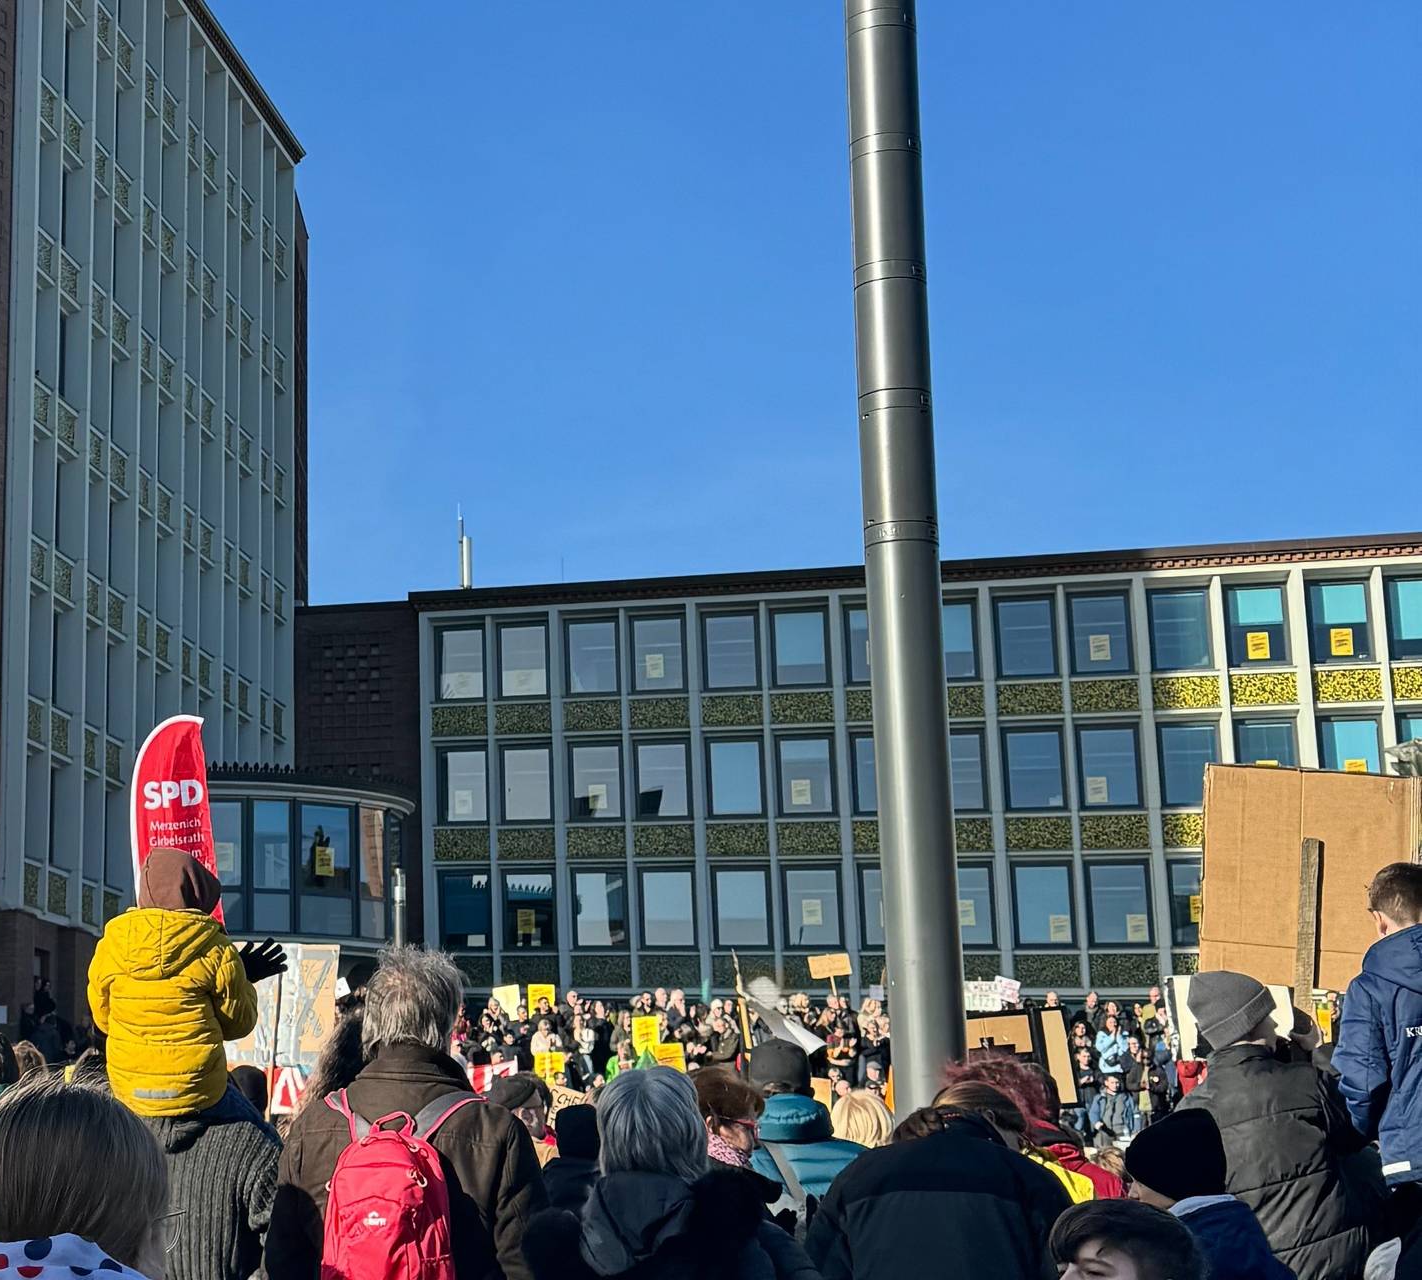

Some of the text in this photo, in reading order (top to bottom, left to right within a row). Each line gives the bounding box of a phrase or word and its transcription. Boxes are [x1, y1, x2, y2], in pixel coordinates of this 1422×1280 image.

[143, 779, 204, 810] SPD
[149, 817, 202, 831] Merzenich
[149, 832, 205, 847] Girbelsrath
